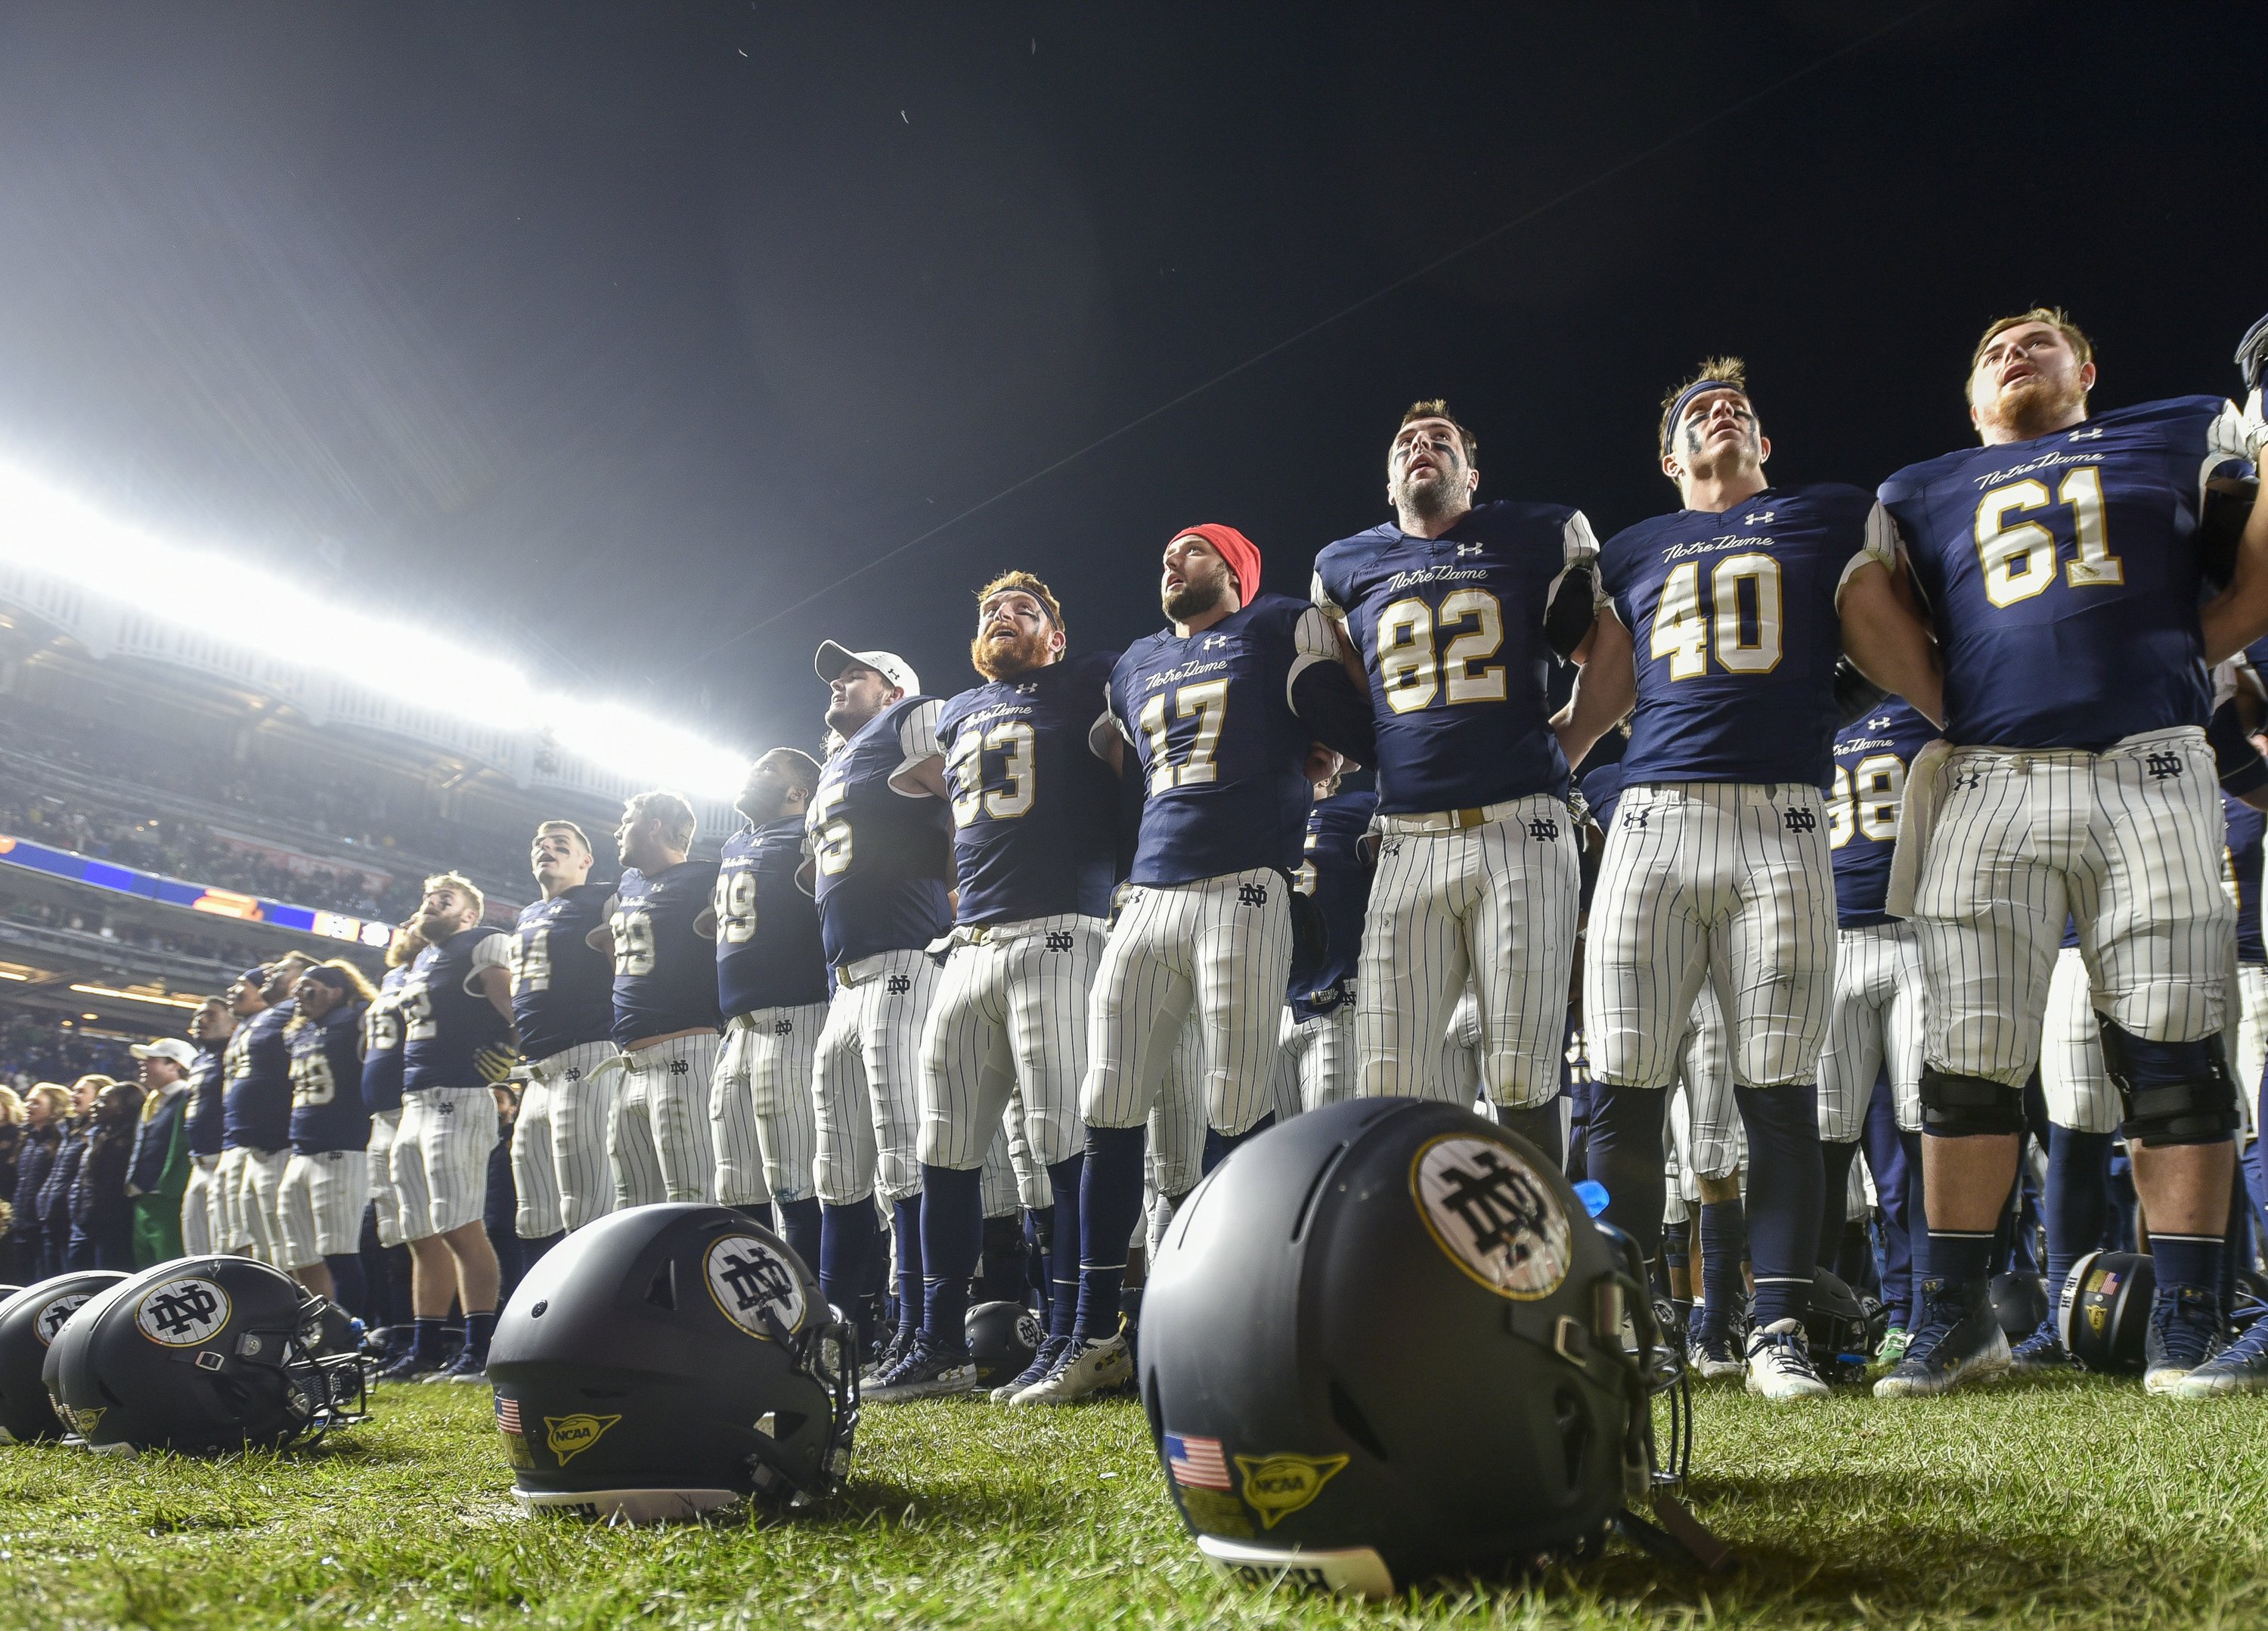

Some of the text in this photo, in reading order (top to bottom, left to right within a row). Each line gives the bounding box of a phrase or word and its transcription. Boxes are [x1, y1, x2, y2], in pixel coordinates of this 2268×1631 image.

[1974, 451, 2105, 490] Notre Dame
[1662, 535, 1775, 563] Notre Dame
[1974, 466, 2124, 609] 61
[1387, 565, 1489, 594] Notre Dame
[1650, 552, 1783, 682] 40
[1377, 588, 1507, 715] 82
[1144, 659, 1228, 692] Notre Dame
[990, 701, 1033, 719] Dame
[1139, 677, 1229, 798] 17
[1833, 736, 1895, 756] re Dame
[946, 720, 1036, 829] 33
[400, 981, 435, 1042] 2
[149, 1284, 218, 1335] ND
[2061, 1277, 2078, 1309] IRSH
[556, 1427, 590, 1442] NCAA
